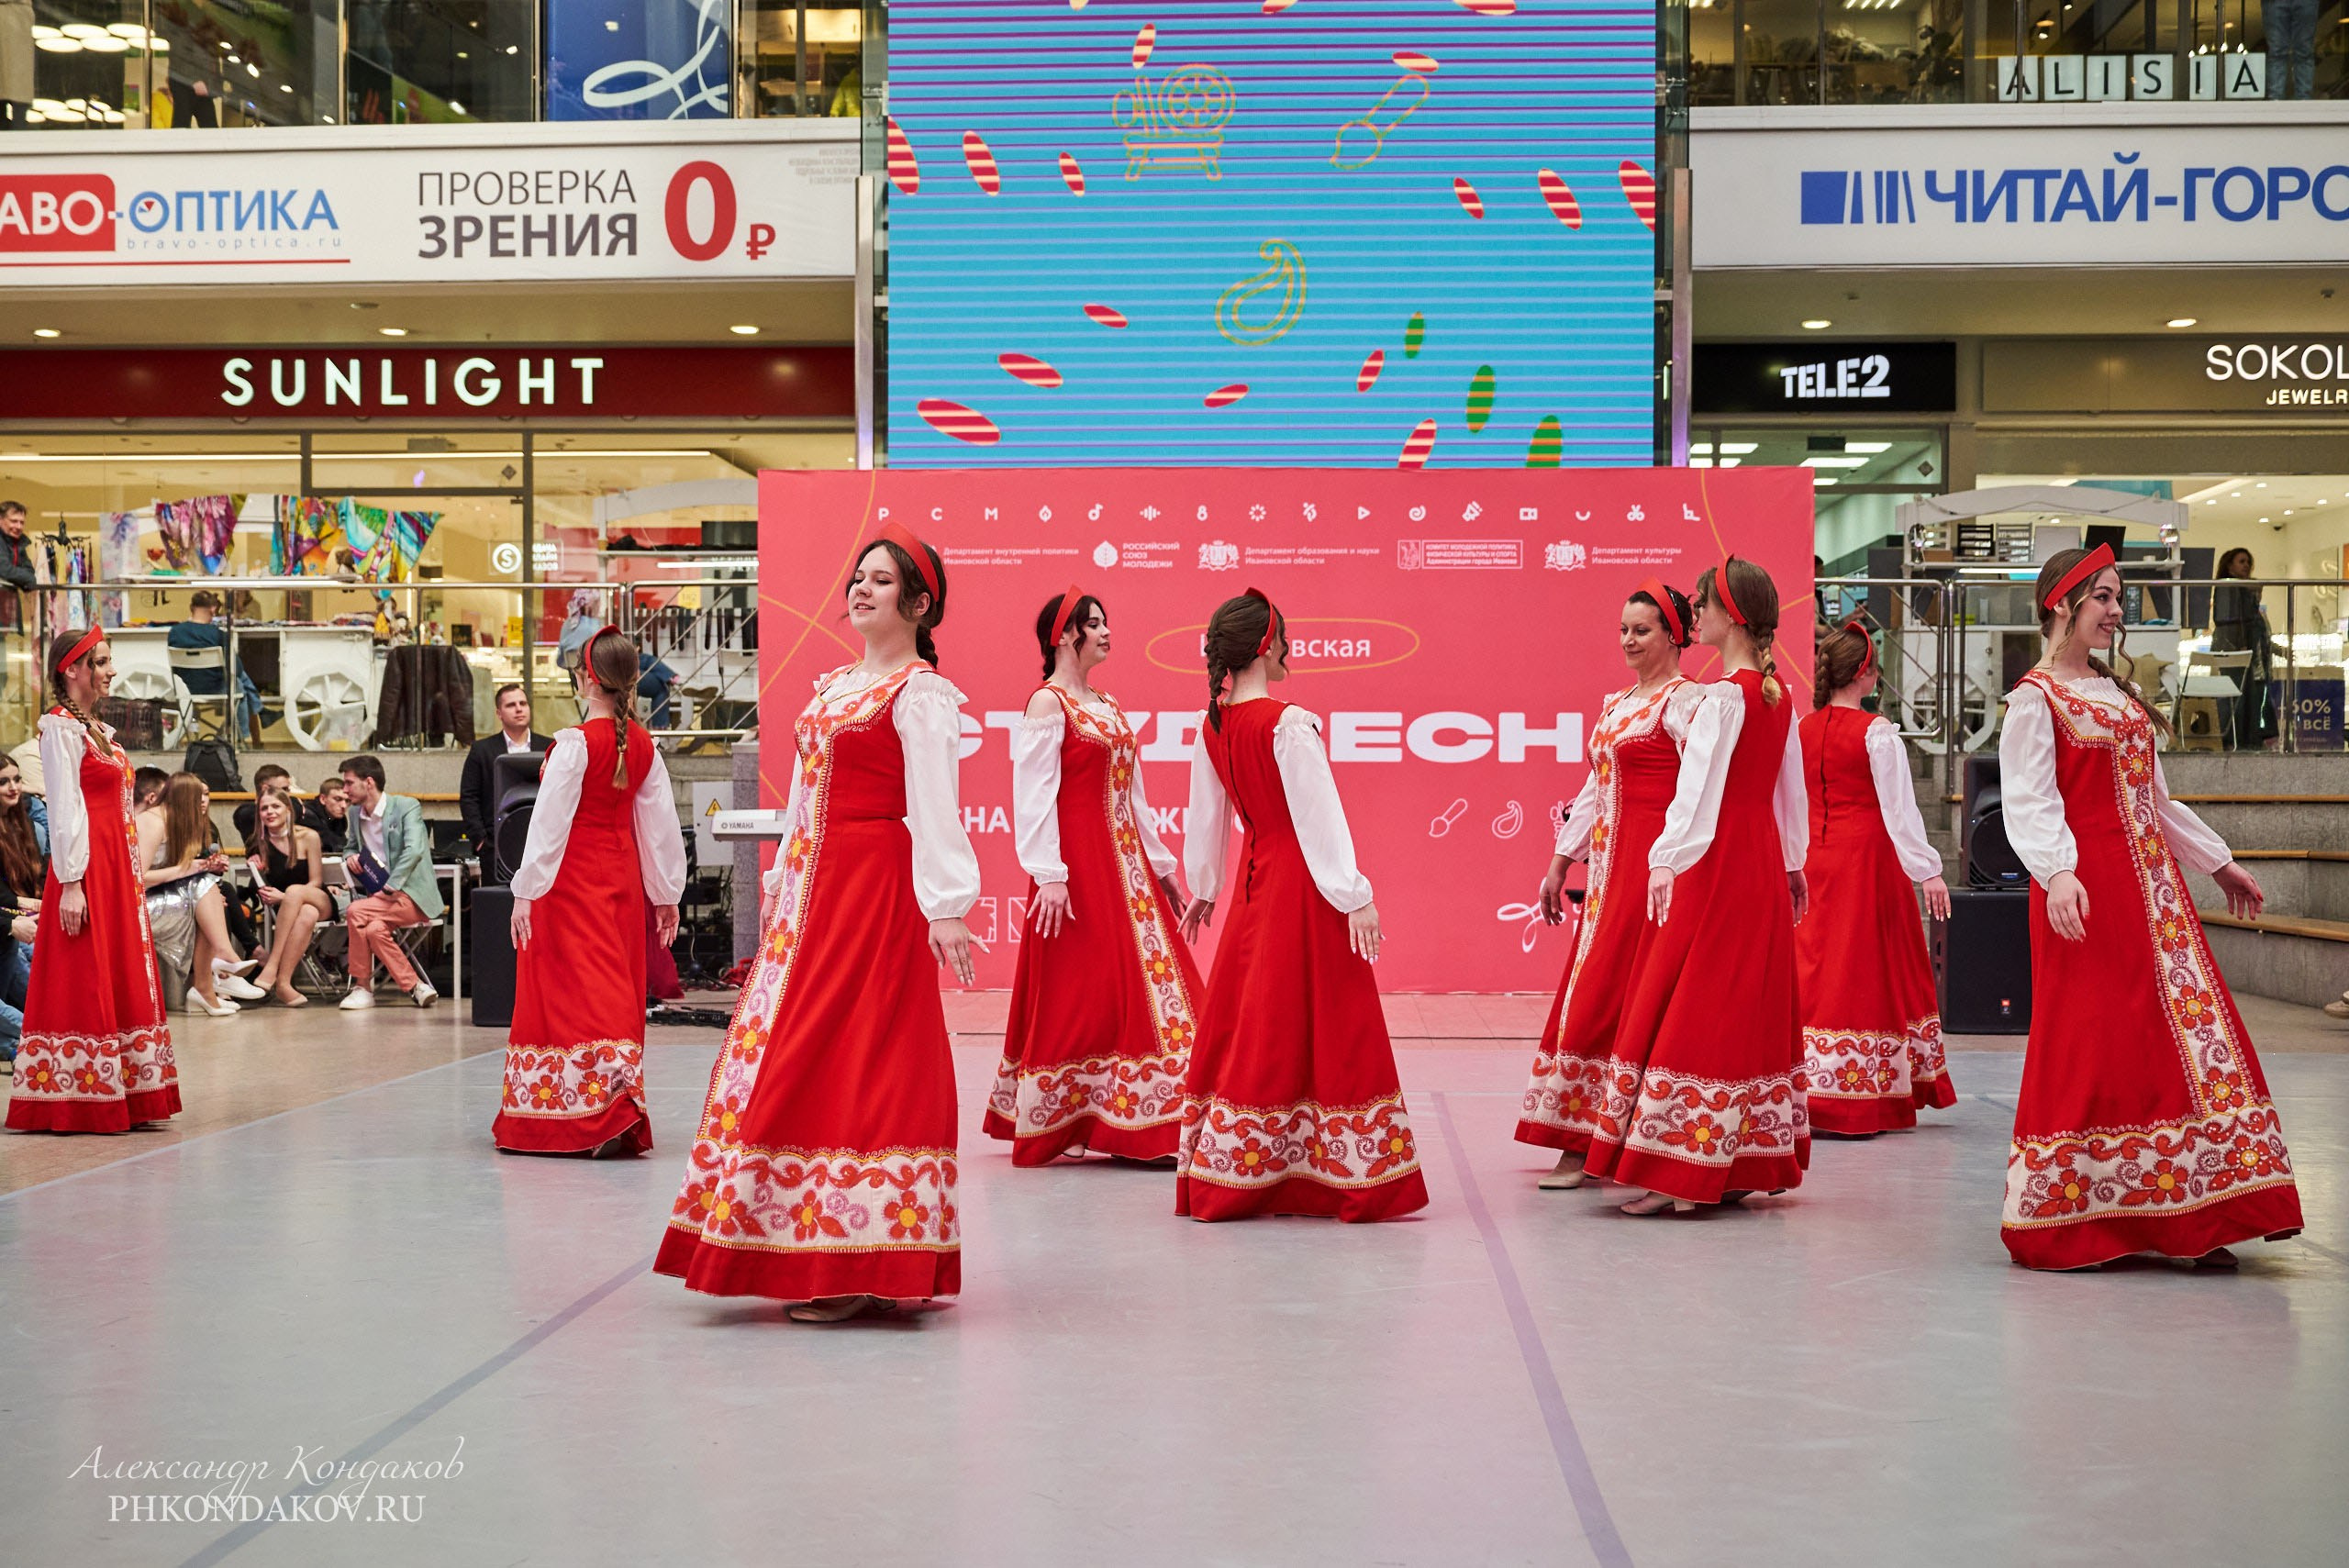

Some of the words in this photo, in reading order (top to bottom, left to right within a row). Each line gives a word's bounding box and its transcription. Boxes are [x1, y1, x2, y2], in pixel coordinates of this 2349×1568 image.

[2006, 60, 2259, 95] ALISIA
[418, 169, 637, 206] ПРОВЕРКА
[417, 212, 638, 260] ЗРЕНИЯ
[128, 236, 342, 250] bravo-optica.ru
[1780, 354, 1890, 398] TELE2
[220, 357, 604, 406] SUNLIGHT
[1122, 541, 1180, 550] РОССИЙСКИЙ
[943, 547, 994, 556] Департамент
[1122, 551, 1148, 560] СОЮЗ
[1245, 547, 1296, 556] Департамент
[1592, 547, 1643, 555] Департамент
[943, 557, 989, 565] Ивановской
[991, 557, 1022, 565] области
[1245, 557, 1292, 565] Ивановской
[1293, 557, 1325, 565] области
[1592, 556, 1639, 564] Ивановской
[1640, 556, 1673, 564] области
[1122, 561, 1173, 569] МОЛОДЕЖИ
[2303, 717, 2331, 730] ВСЁ
[729, 821, 754, 829] YAMAHA
